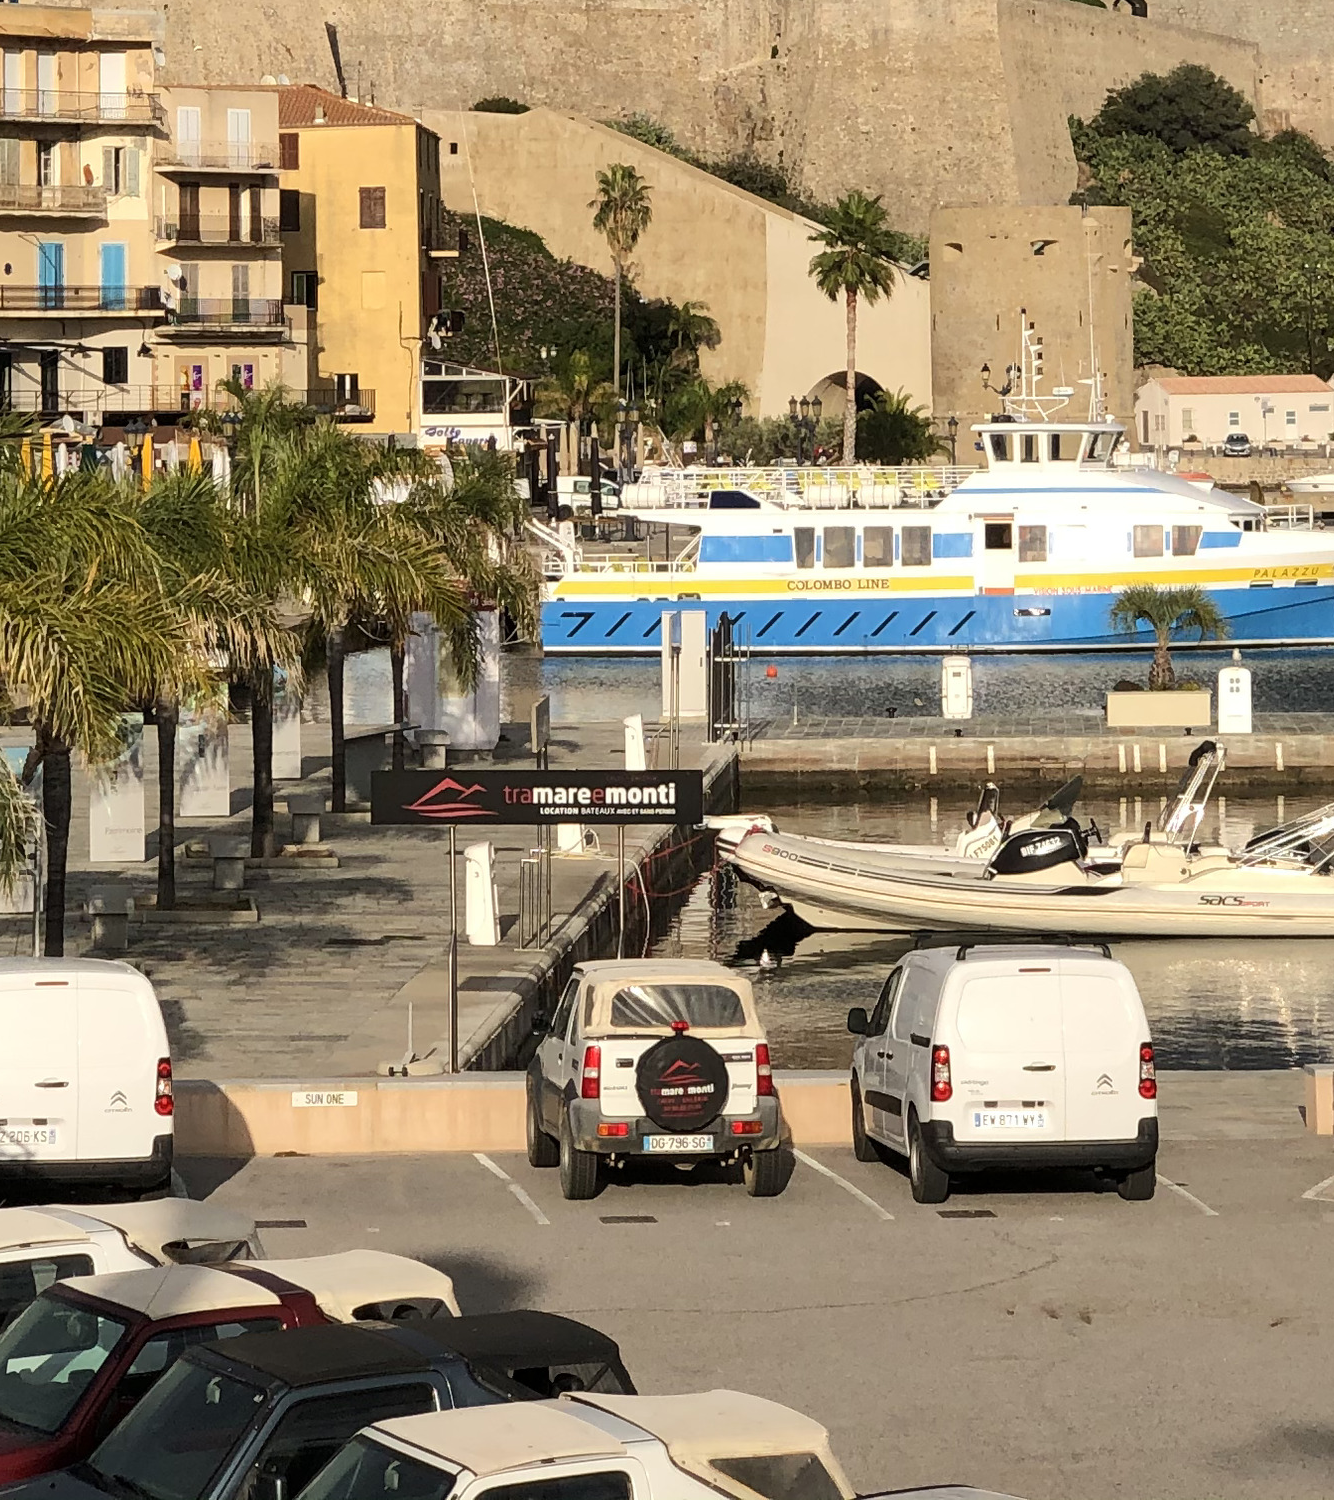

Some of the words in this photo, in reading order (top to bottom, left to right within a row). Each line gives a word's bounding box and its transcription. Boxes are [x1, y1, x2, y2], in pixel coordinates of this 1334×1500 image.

[1253, 567, 1319, 578] PALAZZU
[787, 579, 852, 591] COLOMBO
[857, 578, 890, 590] LINE
[502, 782, 677, 805] tramareemonti
[539, 807, 579, 815] LOCATION
[581, 807, 616, 815] BATEAUX
[305, 1093, 324, 1105] SUN
[326, 1093, 345, 1105] ONE
